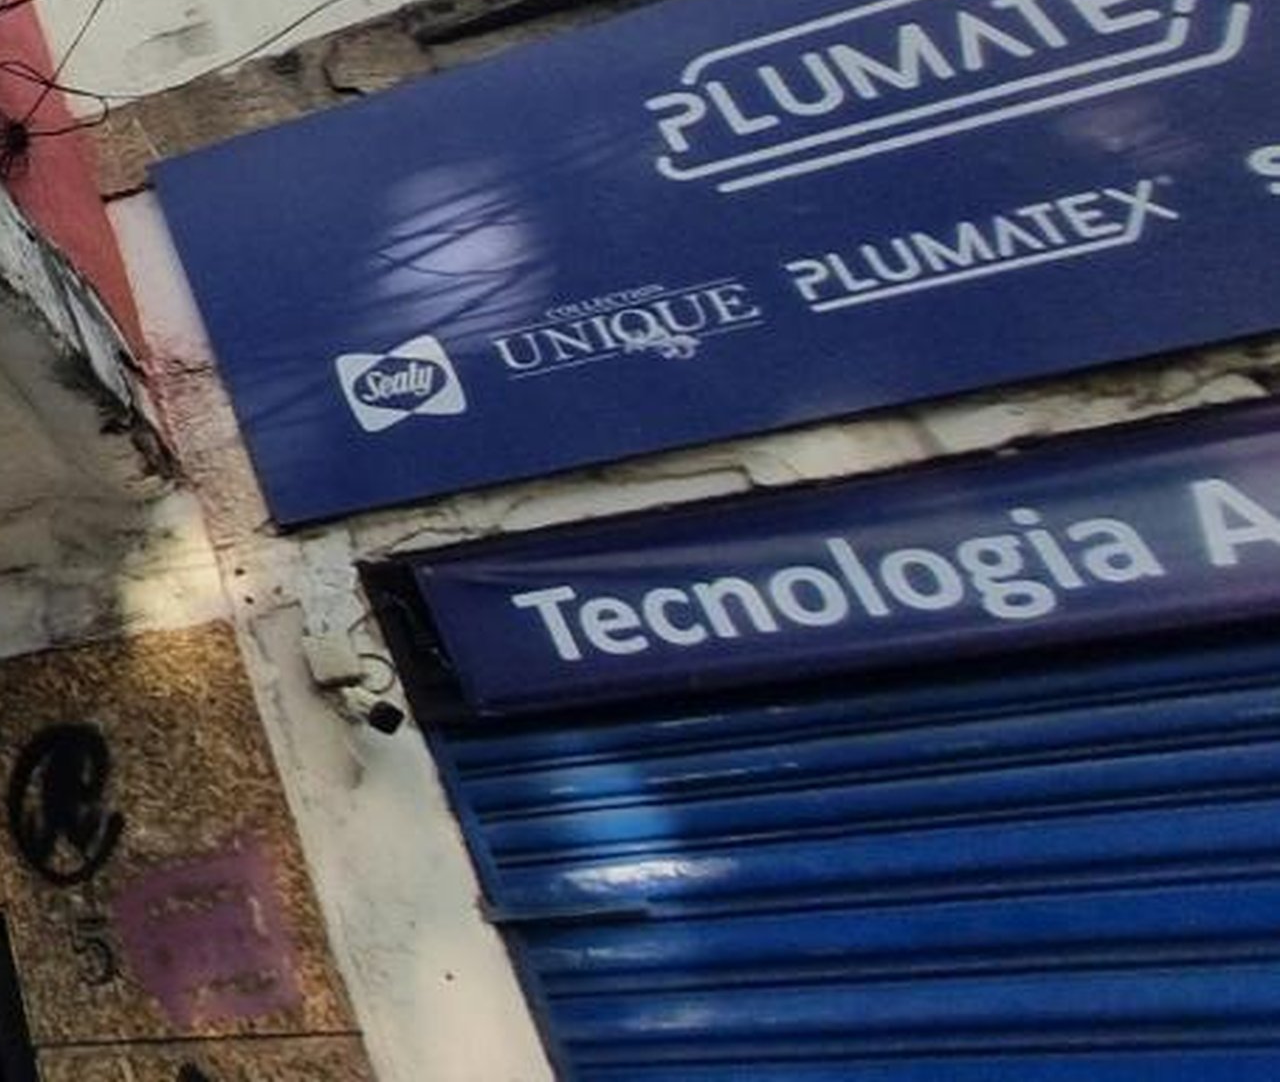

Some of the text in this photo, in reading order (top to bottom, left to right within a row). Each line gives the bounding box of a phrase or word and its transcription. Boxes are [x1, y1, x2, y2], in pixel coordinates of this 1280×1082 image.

[784, 179, 1181, 302] PLUMATEX
[493, 284, 762, 369] UNIQUE
[361, 360, 434, 402] Sealy
[512, 508, 1166, 661] Tecnologia
